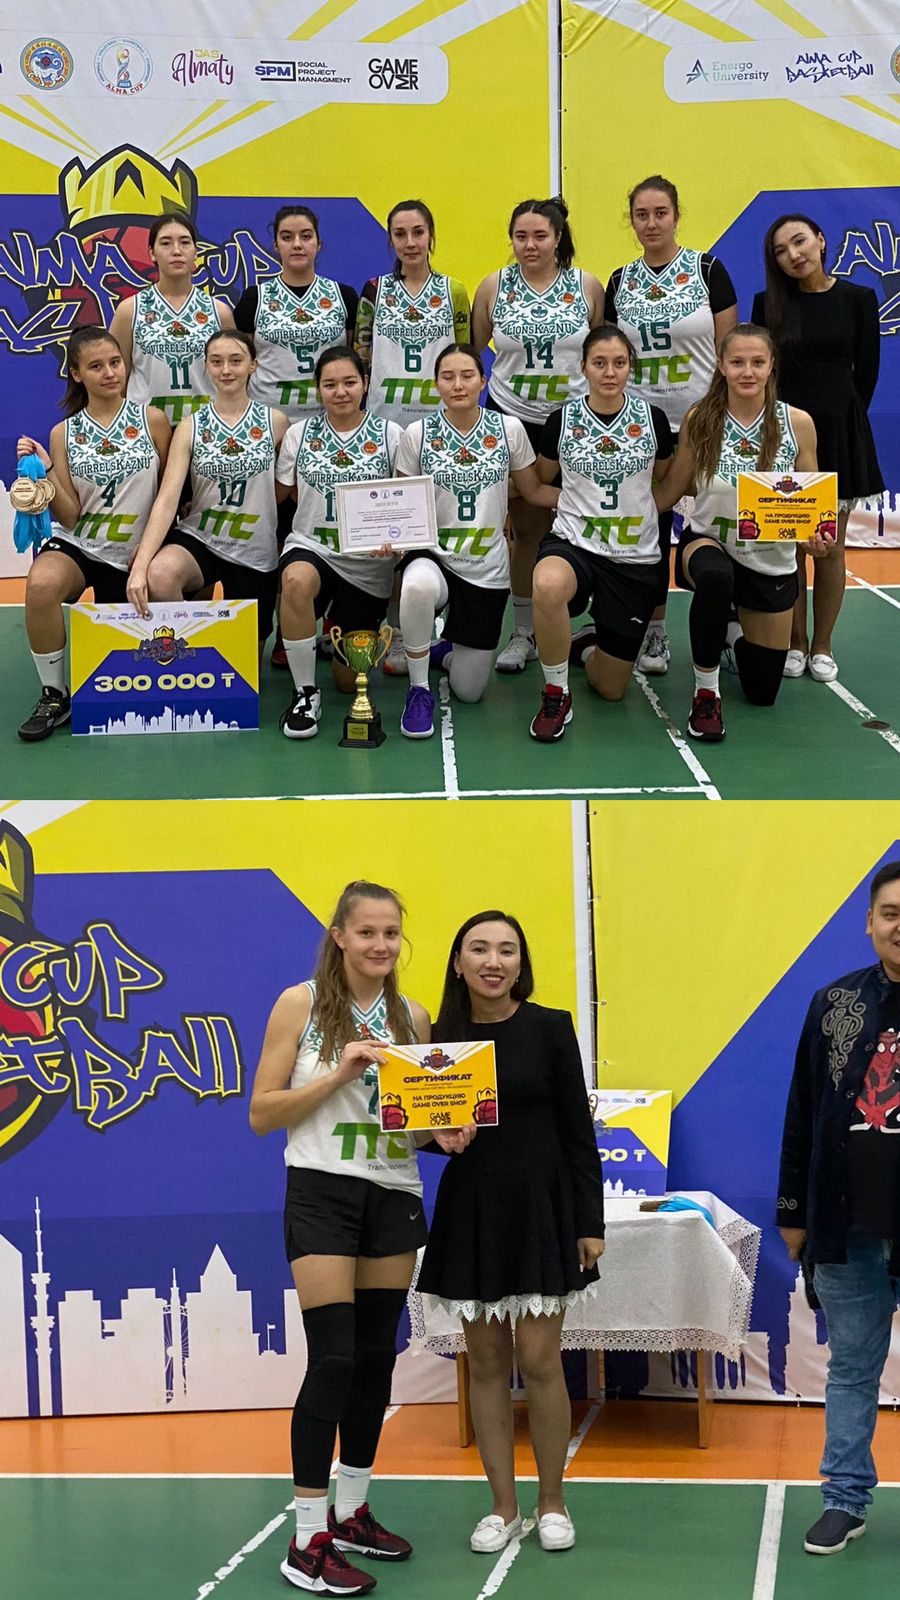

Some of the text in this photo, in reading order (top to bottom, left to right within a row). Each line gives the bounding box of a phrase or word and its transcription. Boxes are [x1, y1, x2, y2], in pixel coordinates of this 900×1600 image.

[195, 49, 219, 58] JAS
[368, 58, 418, 74] GAME
[712, 61, 753, 72] Energo
[838, 50, 862, 64] CUP
[172, 50, 235, 87] Almaty
[255, 65, 291, 77] SPM
[713, 71, 769, 82] University
[106, 83, 144, 95] ALMA CUP
[368, 74, 419, 90] OVER
[377, 325, 451, 337] SQUIRRELSKAZNU
[507, 323, 573, 335] LIONSKAZNU
[638, 322, 672, 351] 15
[141, 342, 207, 355] SQUIRRELSKAZ
[296, 345, 315, 374] 5
[405, 345, 422, 373] 6
[524, 341, 554, 369] 14
[169, 361, 192, 390] 11
[509, 375, 570, 401] TTC
[568, 458, 649, 472] SQUIRRELSKAZNU
[101, 480, 117, 507] 4
[218, 480, 247, 507] 10
[458, 490, 476, 521] 8
[600, 480, 618, 510] 3
[74, 512, 138, 542] TTC
[198, 509, 260, 540] TTC
[580, 515, 644, 545] TTC
[438, 527, 496, 556] TTC
[94, 675, 152, 692] 300
[157, 672, 215, 690] 000
[0, 923, 163, 1018] CUP
[403, 1074, 473, 1083] СЕРТИФИКАТ
[424, 1093, 466, 1101] ПРОДУКЦИЮ
